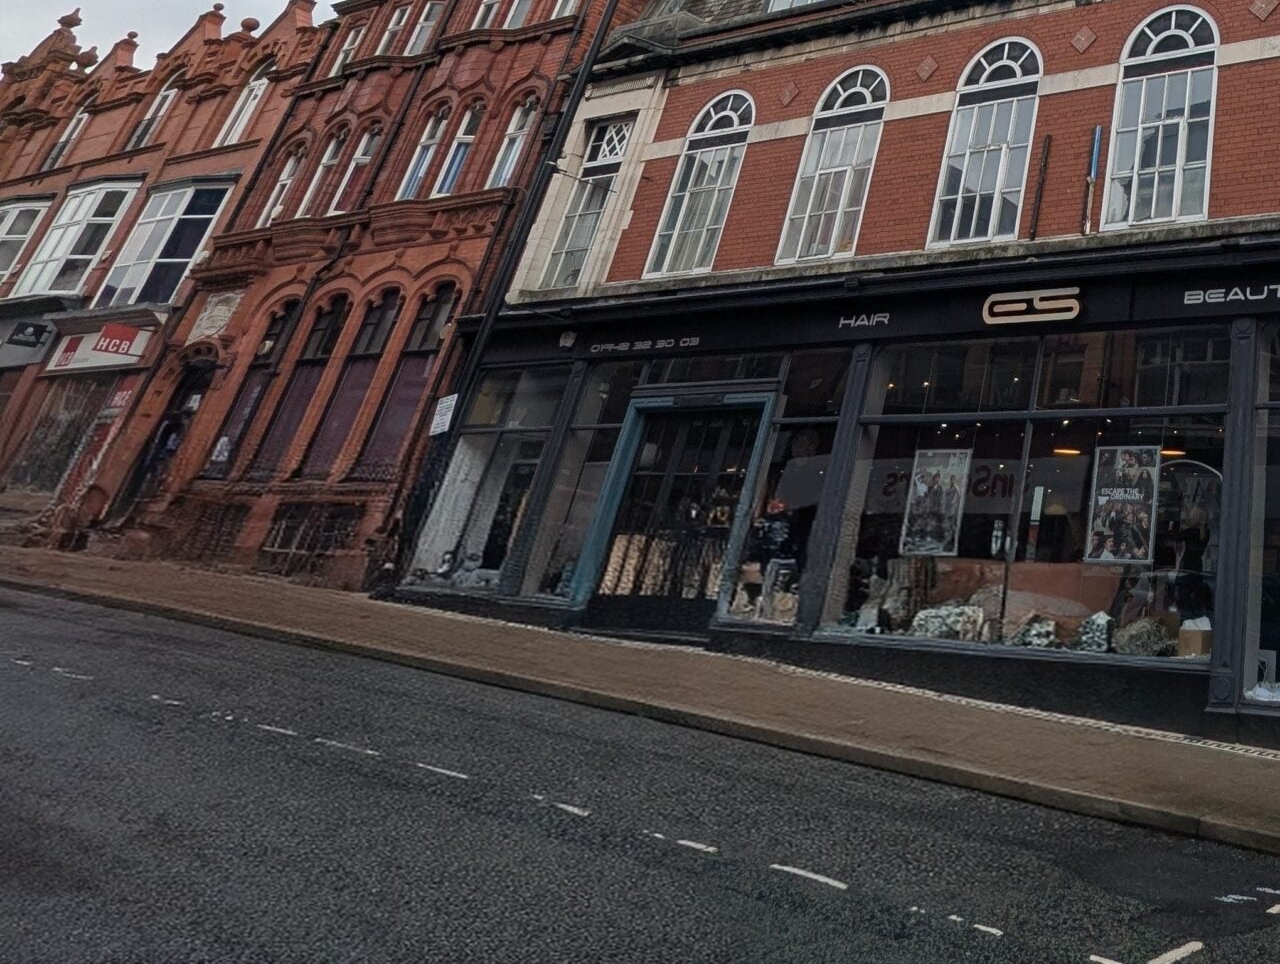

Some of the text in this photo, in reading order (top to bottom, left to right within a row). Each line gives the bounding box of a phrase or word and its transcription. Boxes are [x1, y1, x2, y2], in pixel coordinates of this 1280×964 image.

[982, 286, 1080, 325] ES
[838, 312, 890, 329] HAIR
[96, 337, 130, 354] HCB
[632, 340, 652, 350] 32
[655, 339, 675, 348] 30
[679, 337, 700, 347] 03
[1101, 487, 1125, 495] ESCAPE
[1110, 493, 1144, 501] ORDINARY
